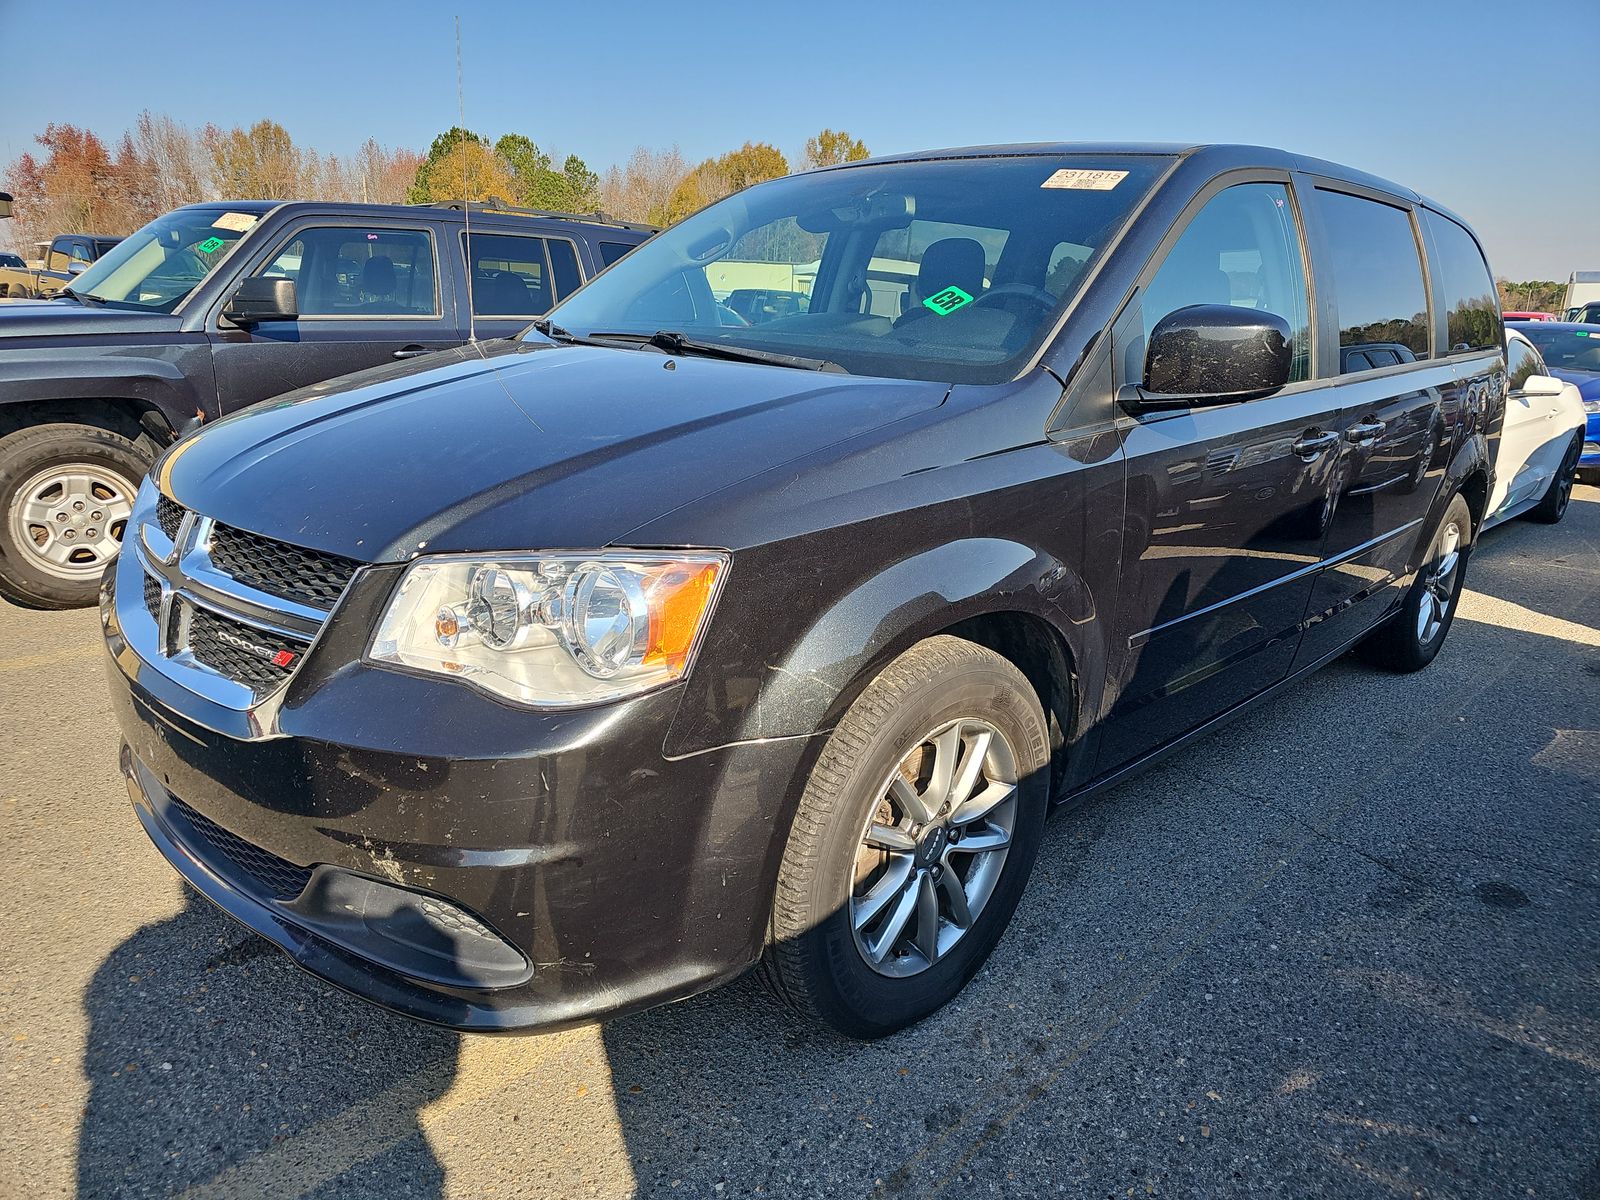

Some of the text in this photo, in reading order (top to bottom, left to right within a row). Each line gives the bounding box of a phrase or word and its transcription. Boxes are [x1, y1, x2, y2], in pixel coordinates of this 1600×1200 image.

[1056, 170, 1121, 180] 2311815
[203, 240, 219, 251] CR
[931, 290, 965, 311] CR
[218, 631, 278, 659] DODGE
[1010, 698, 1048, 769] MICHELI
